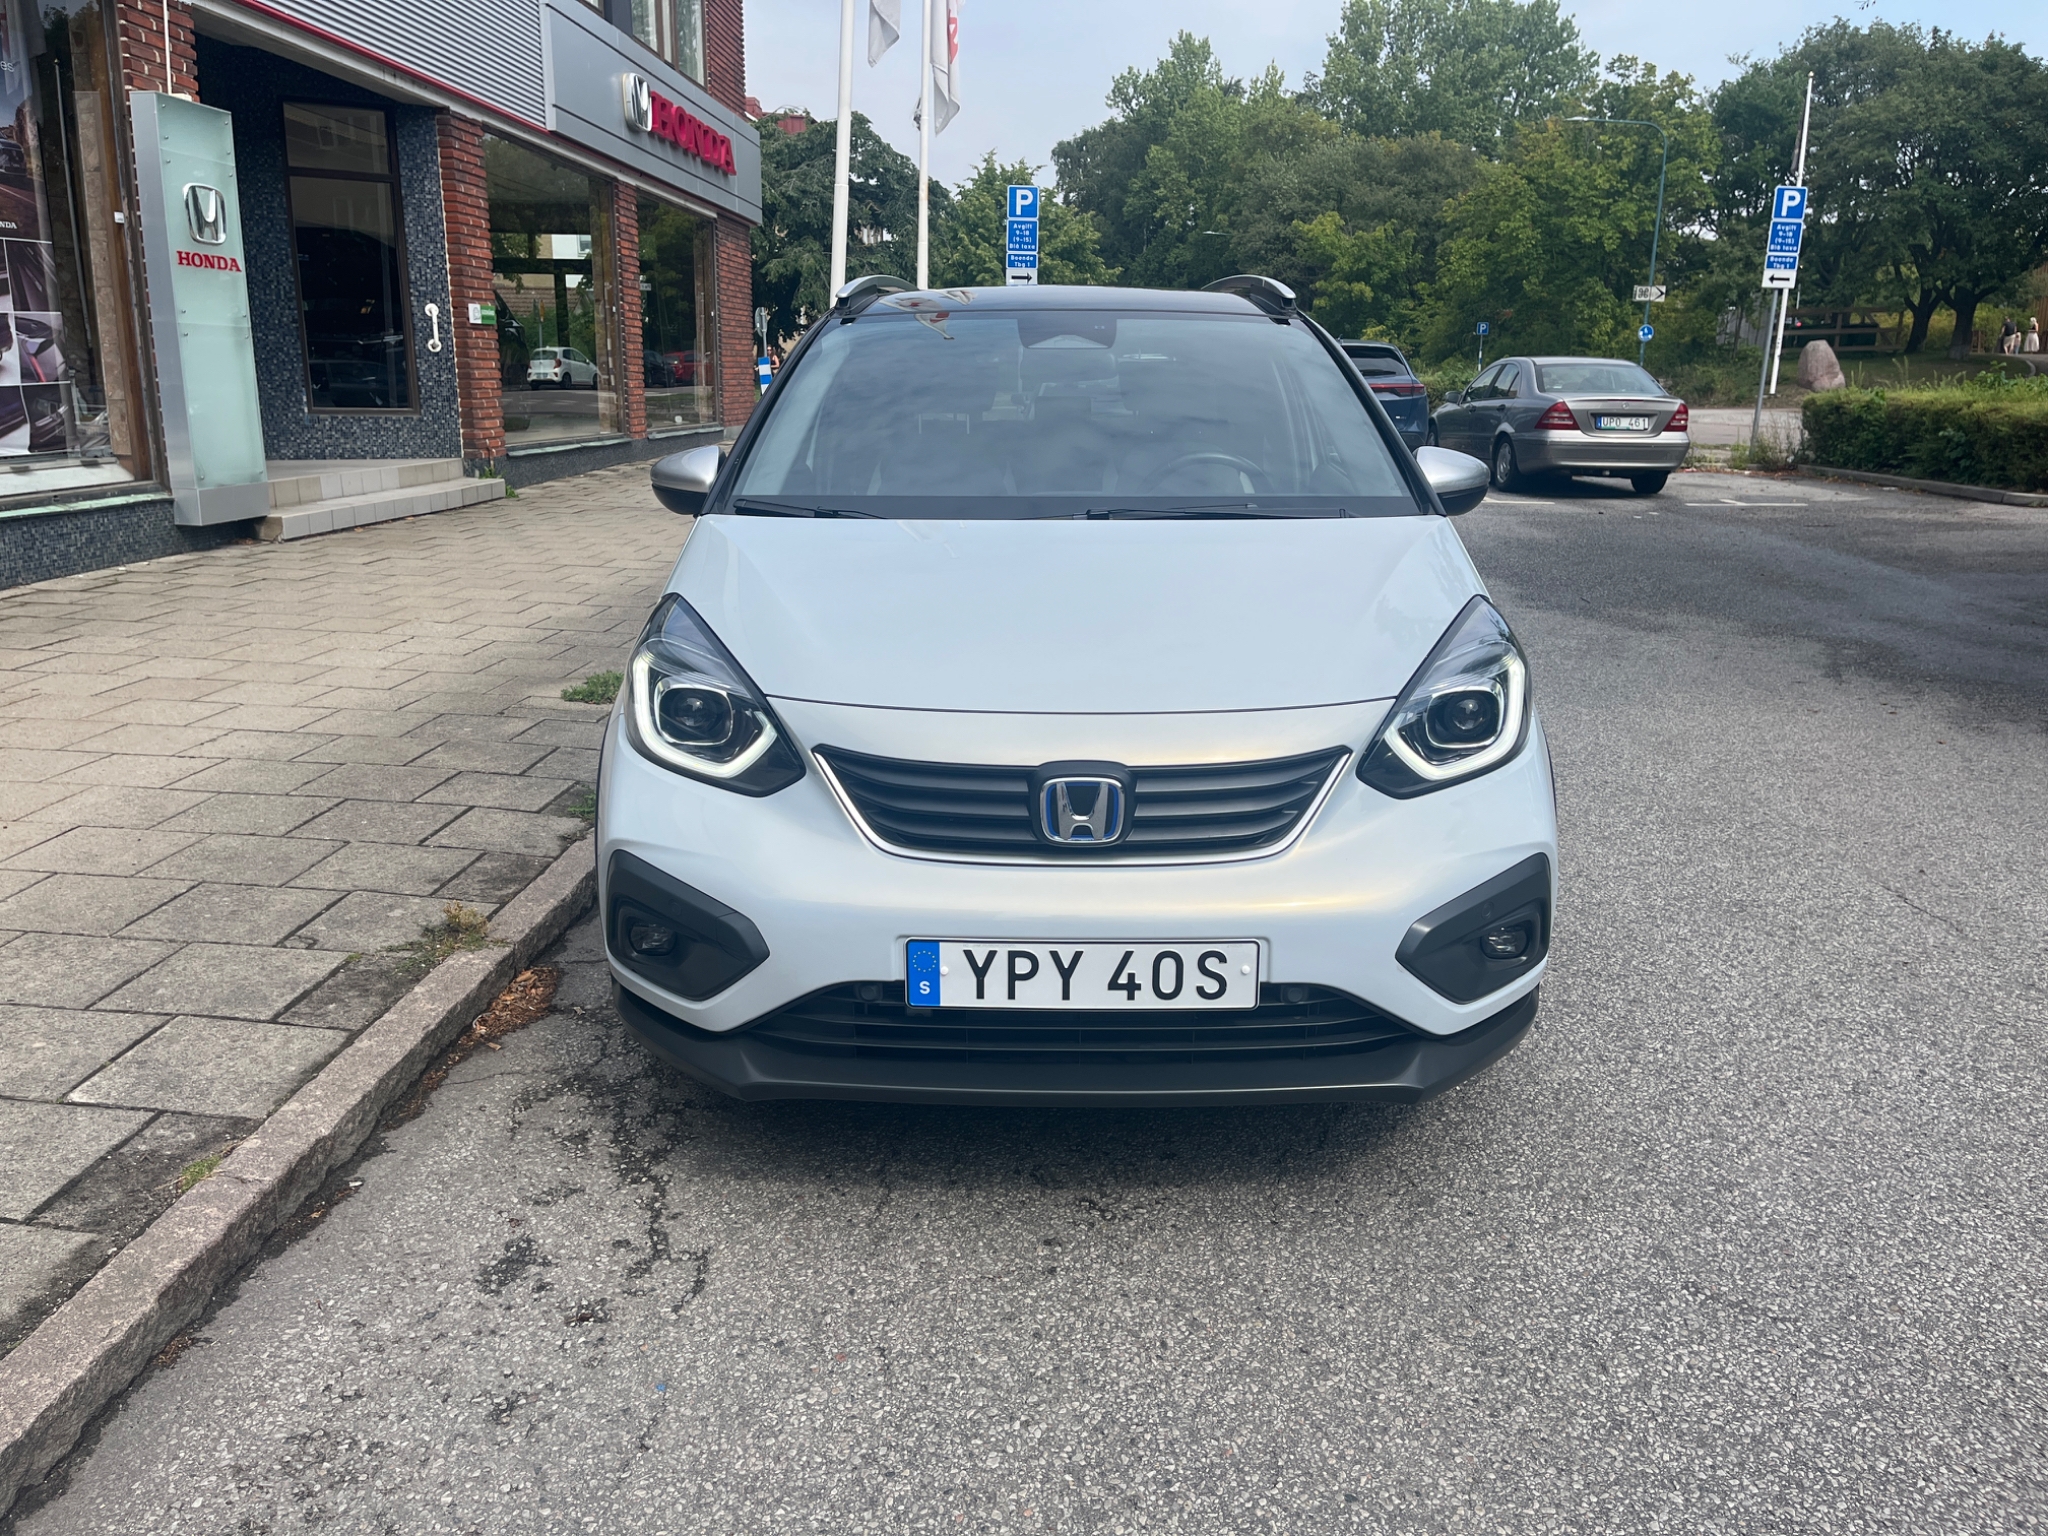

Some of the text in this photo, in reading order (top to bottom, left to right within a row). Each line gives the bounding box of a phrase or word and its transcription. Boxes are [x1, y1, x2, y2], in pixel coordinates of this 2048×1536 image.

[651, 90, 737, 176] HONDA
[1016, 189, 1034, 216] P
[1781, 189, 1801, 217] P
[176, 250, 242, 273] HONDA
[1480, 323, 1487, 334] P
[919, 980, 931, 995] S
[963, 949, 1228, 1001] YPY 40S
